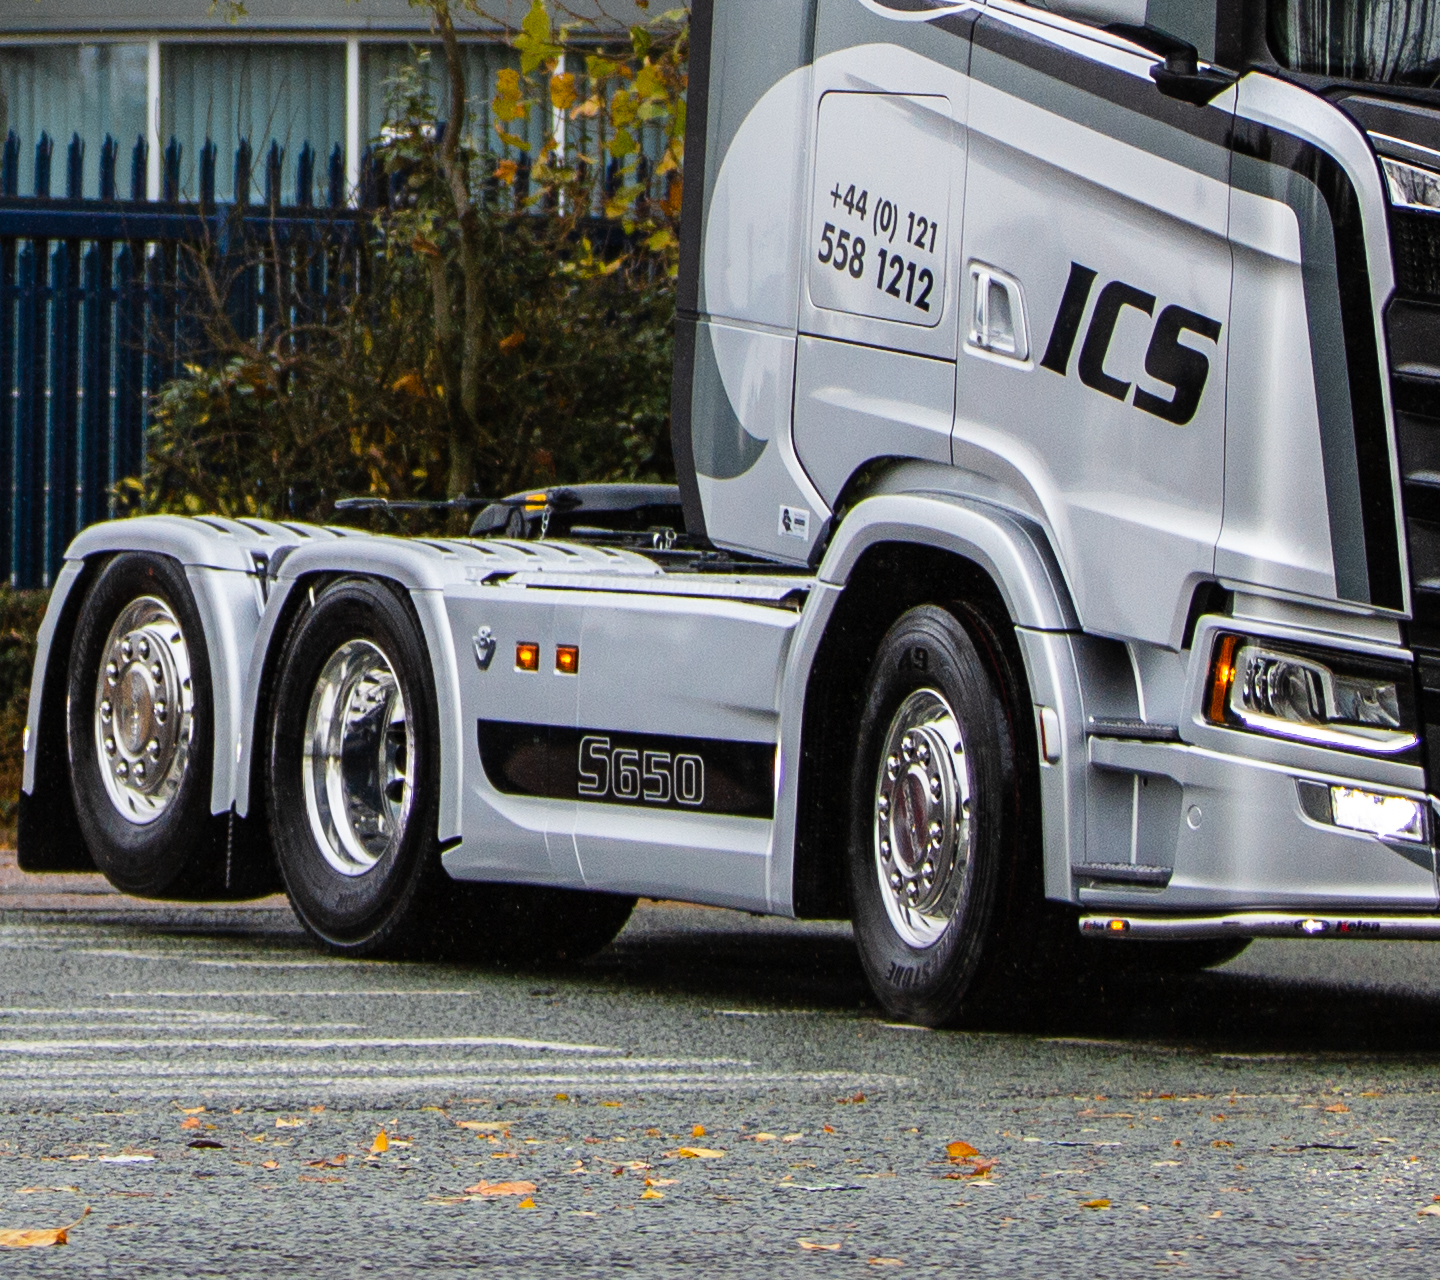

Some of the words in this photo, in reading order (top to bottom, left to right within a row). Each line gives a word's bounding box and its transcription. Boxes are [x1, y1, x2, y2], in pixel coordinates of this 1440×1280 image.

[830, 183, 868, 221] +44
[873, 197, 898, 243] (0)
[906, 212, 938, 254] 121
[818, 223, 866, 279] 558
[876, 248, 934, 313] 1212
[1040, 261, 1222, 426] ICS
[578, 735, 705, 805] S650
